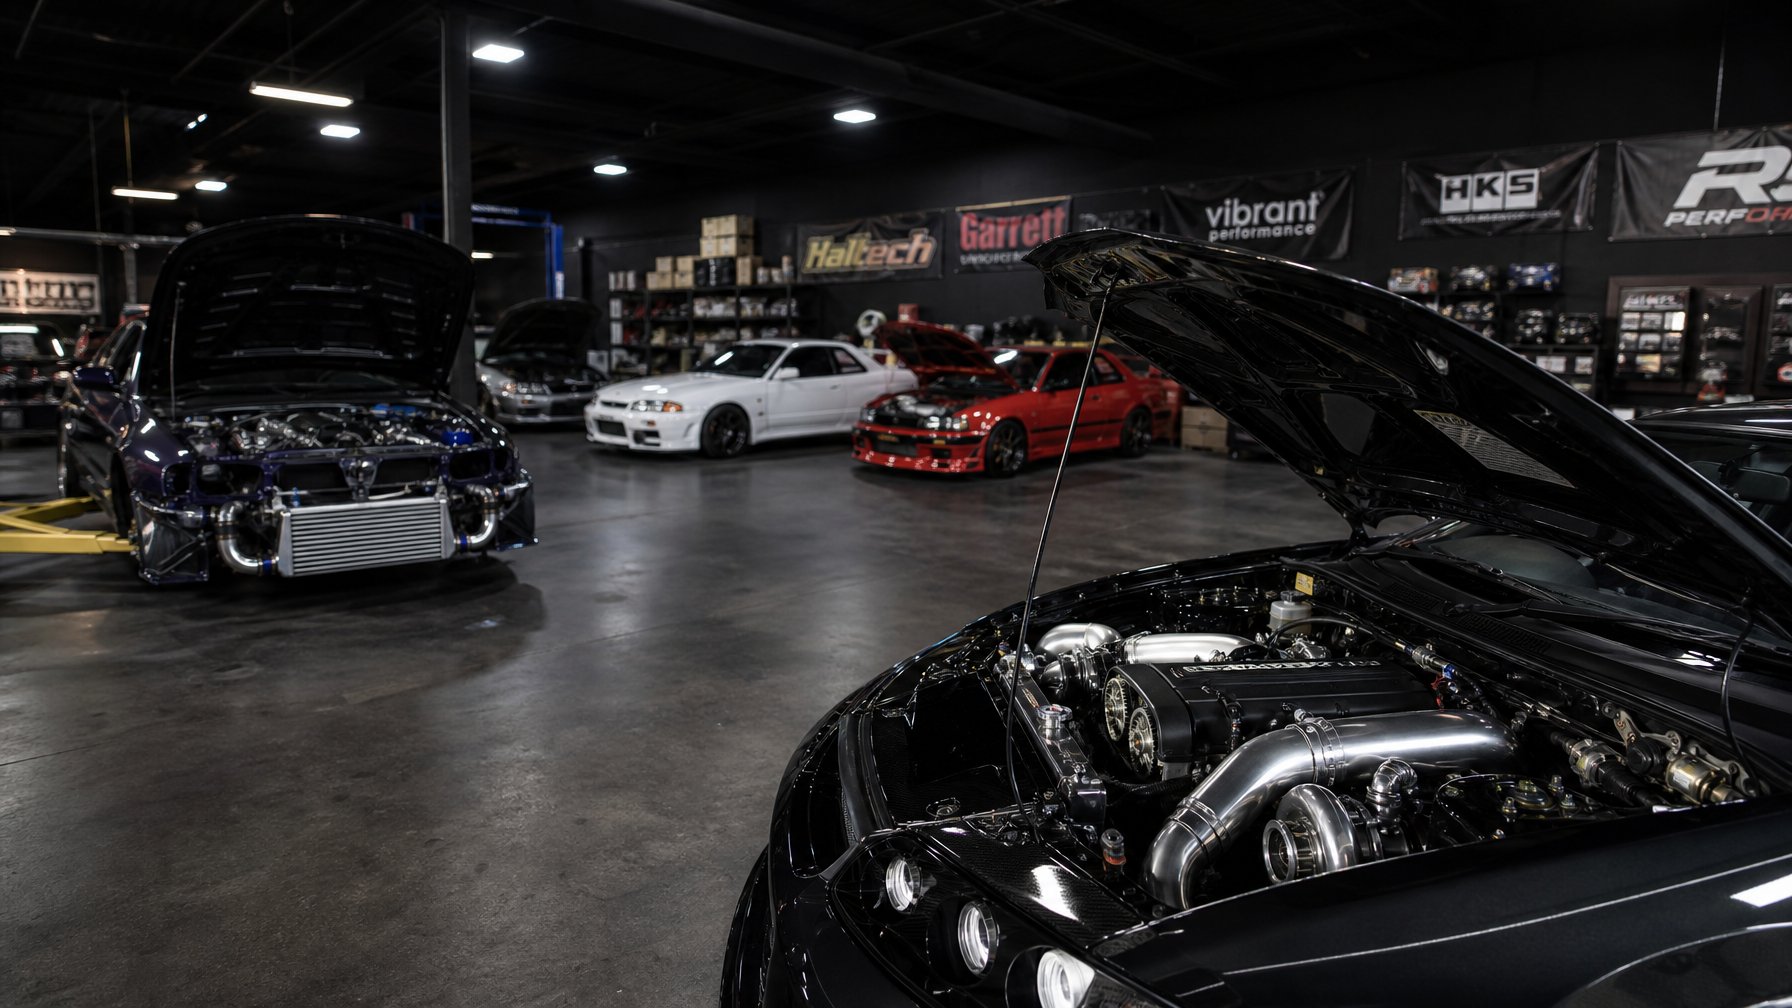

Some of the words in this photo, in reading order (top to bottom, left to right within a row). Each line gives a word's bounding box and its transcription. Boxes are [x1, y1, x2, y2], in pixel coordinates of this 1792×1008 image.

[1444, 171, 1536, 202] HKS
[1673, 145, 1792, 209] R
[960, 206, 1065, 251] Garrett
[1205, 191, 1319, 228] vibrant
[804, 231, 935, 270] Haltech
[1208, 223, 1317, 243] performance
